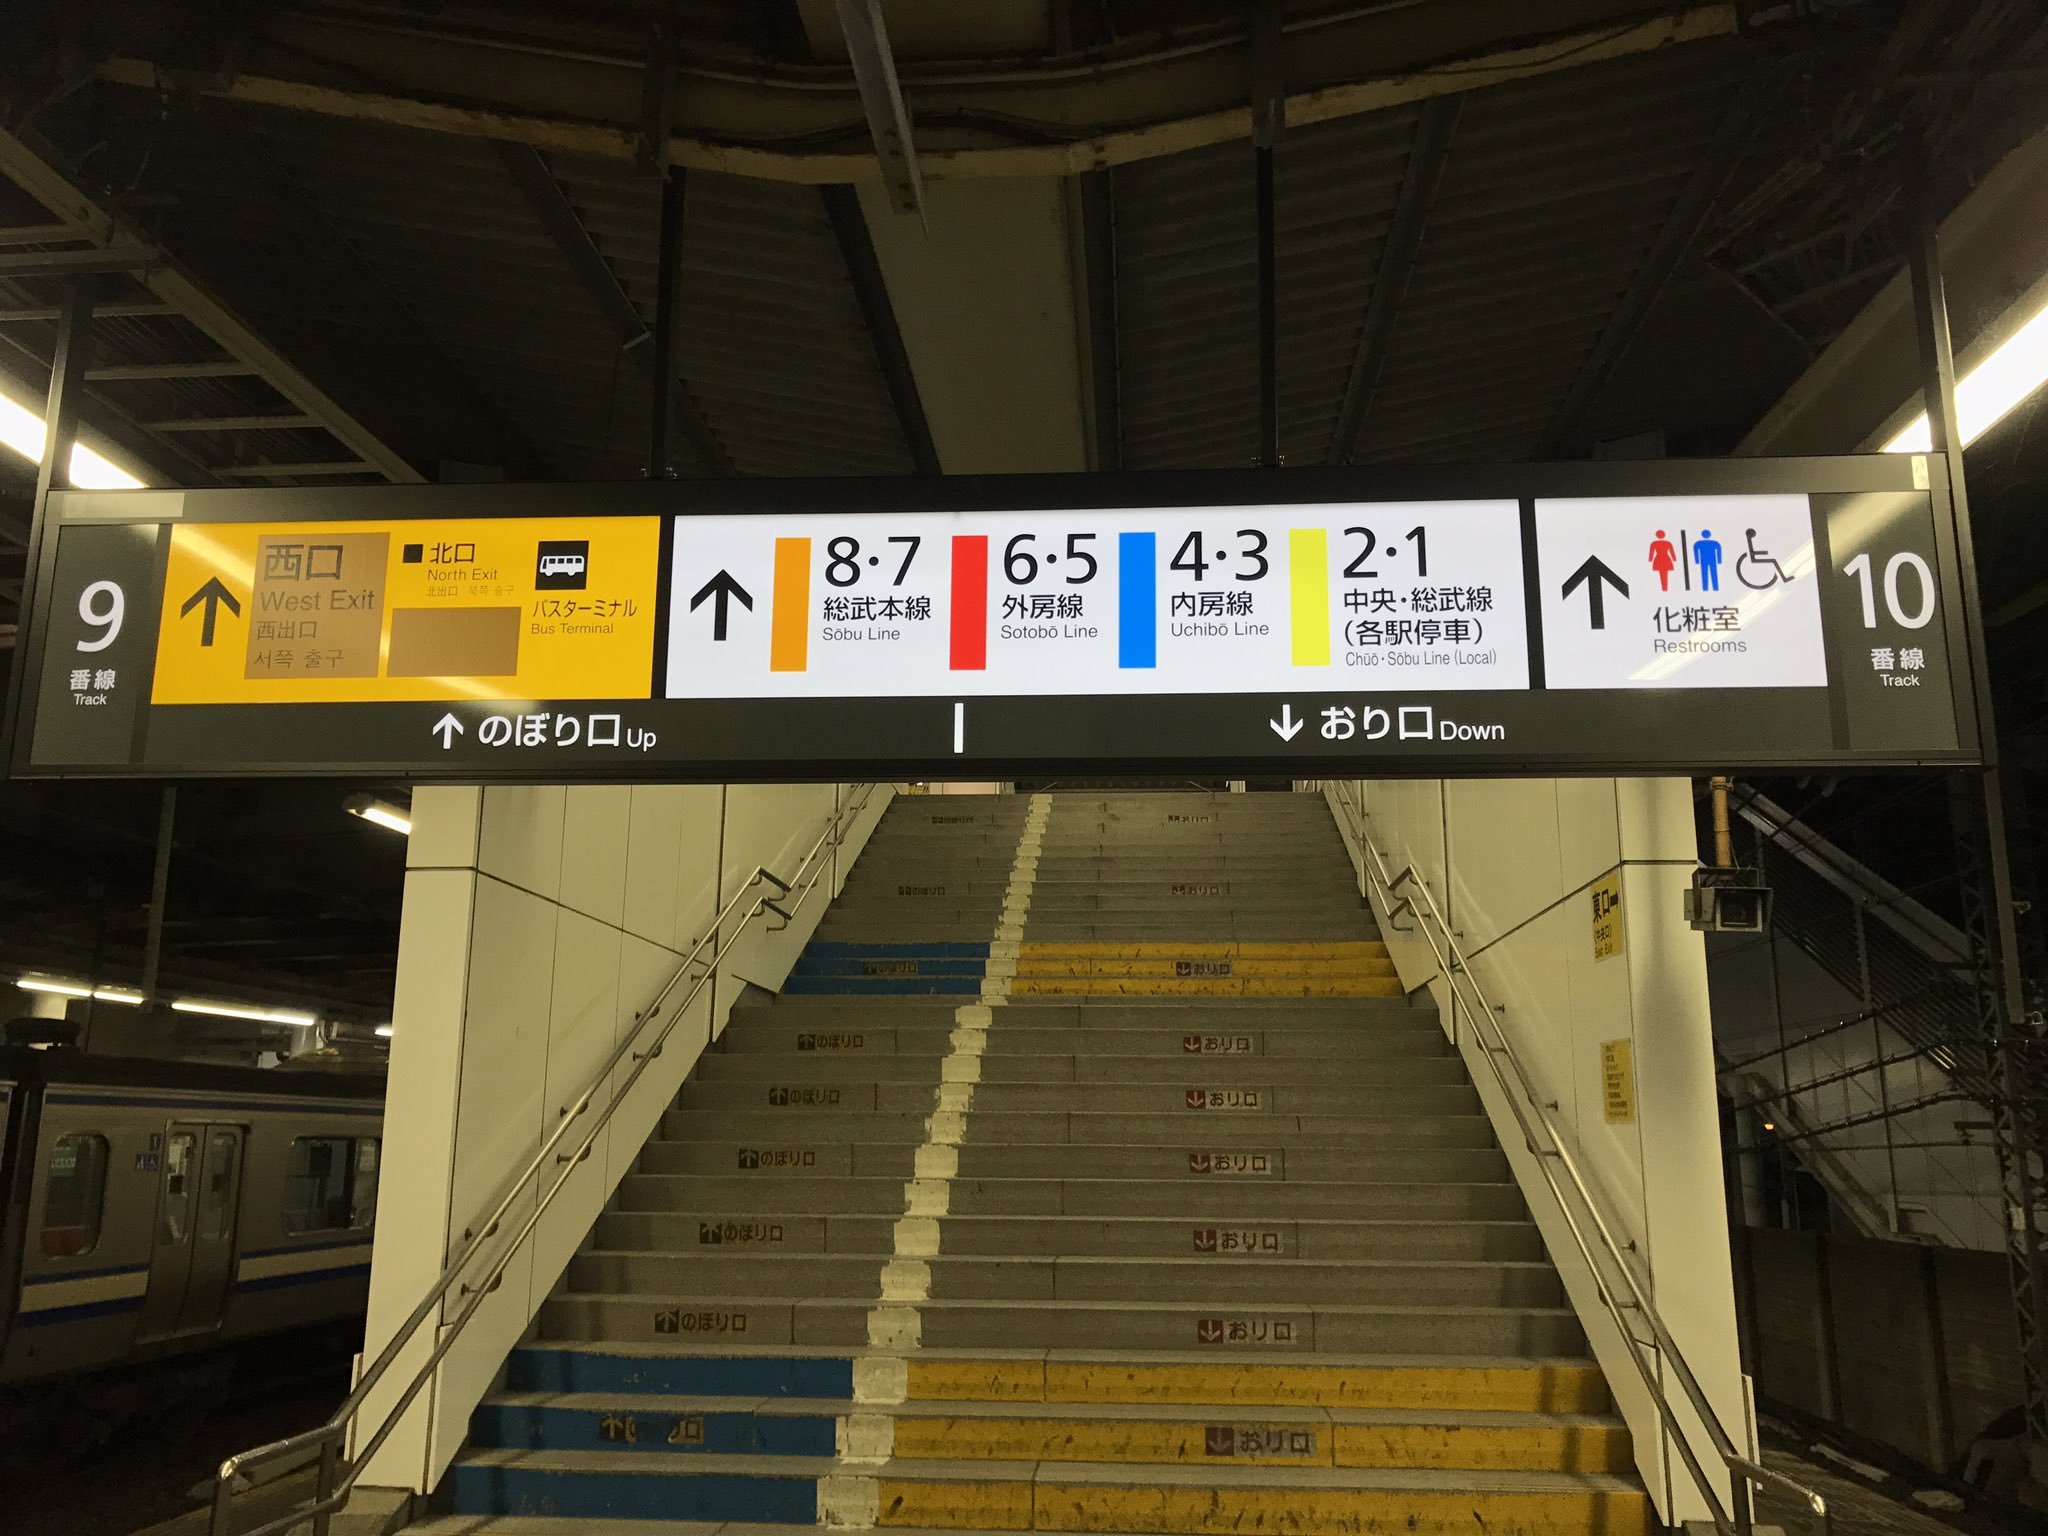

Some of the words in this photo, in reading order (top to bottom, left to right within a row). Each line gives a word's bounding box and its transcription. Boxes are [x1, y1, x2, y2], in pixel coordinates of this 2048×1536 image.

[263, 543, 344, 581] 西口
[429, 542, 476, 564] 北口
[427, 569, 467, 581] North
[471, 568, 499, 581] Exit
[260, 591, 321, 611] West
[330, 589, 376, 610] Exit
[426, 586, 458, 597] 北出口
[1343, 586, 1494, 614] 中央・総武線
[1843, 552, 1935, 629] 10
[532, 599, 638, 618] バスターミナル
[823, 596, 932, 621] 総武本線
[1002, 593, 1084, 620] 外房線
[1171, 590, 1254, 618] 内房線
[77, 580, 125, 652] 9
[1653, 605, 1741, 633] 化粧室
[257, 620, 318, 641] 西出口
[531, 623, 556, 635] Bus
[560, 623, 614, 635] Terminal
[822, 627, 862, 641] Sōbu
[868, 626, 901, 641] Line
[1000, 625, 1058, 639] Sotobō
[1064, 624, 1098, 639] Line
[1171, 622, 1229, 637] Uchibō
[1234, 621, 1270, 636] Line
[1654, 639, 1748, 653] Restrooms
[304, 648, 345, 669] 출구
[1423, 651, 1450, 665] Line
[1454, 649, 1497, 666] (Local)
[1870, 647, 1925, 671] 番線
[70, 668, 116, 690] 番線
[1879, 674, 1920, 687] Track
[74, 693, 107, 706] Track
[478, 712, 622, 747] のぼり口
[626, 728, 657, 752] Up
[1320, 706, 1434, 740] おり口
[1440, 721, 1505, 741] Down
[1205, 1036, 1249, 1051] おり口
[1210, 1092, 1258, 1107] おり口
[1214, 1155, 1267, 1172] おり口
[1221, 1232, 1279, 1250] おり口
[1228, 1321, 1291, 1341] おり口
[1240, 1430, 1311, 1454] おり口
